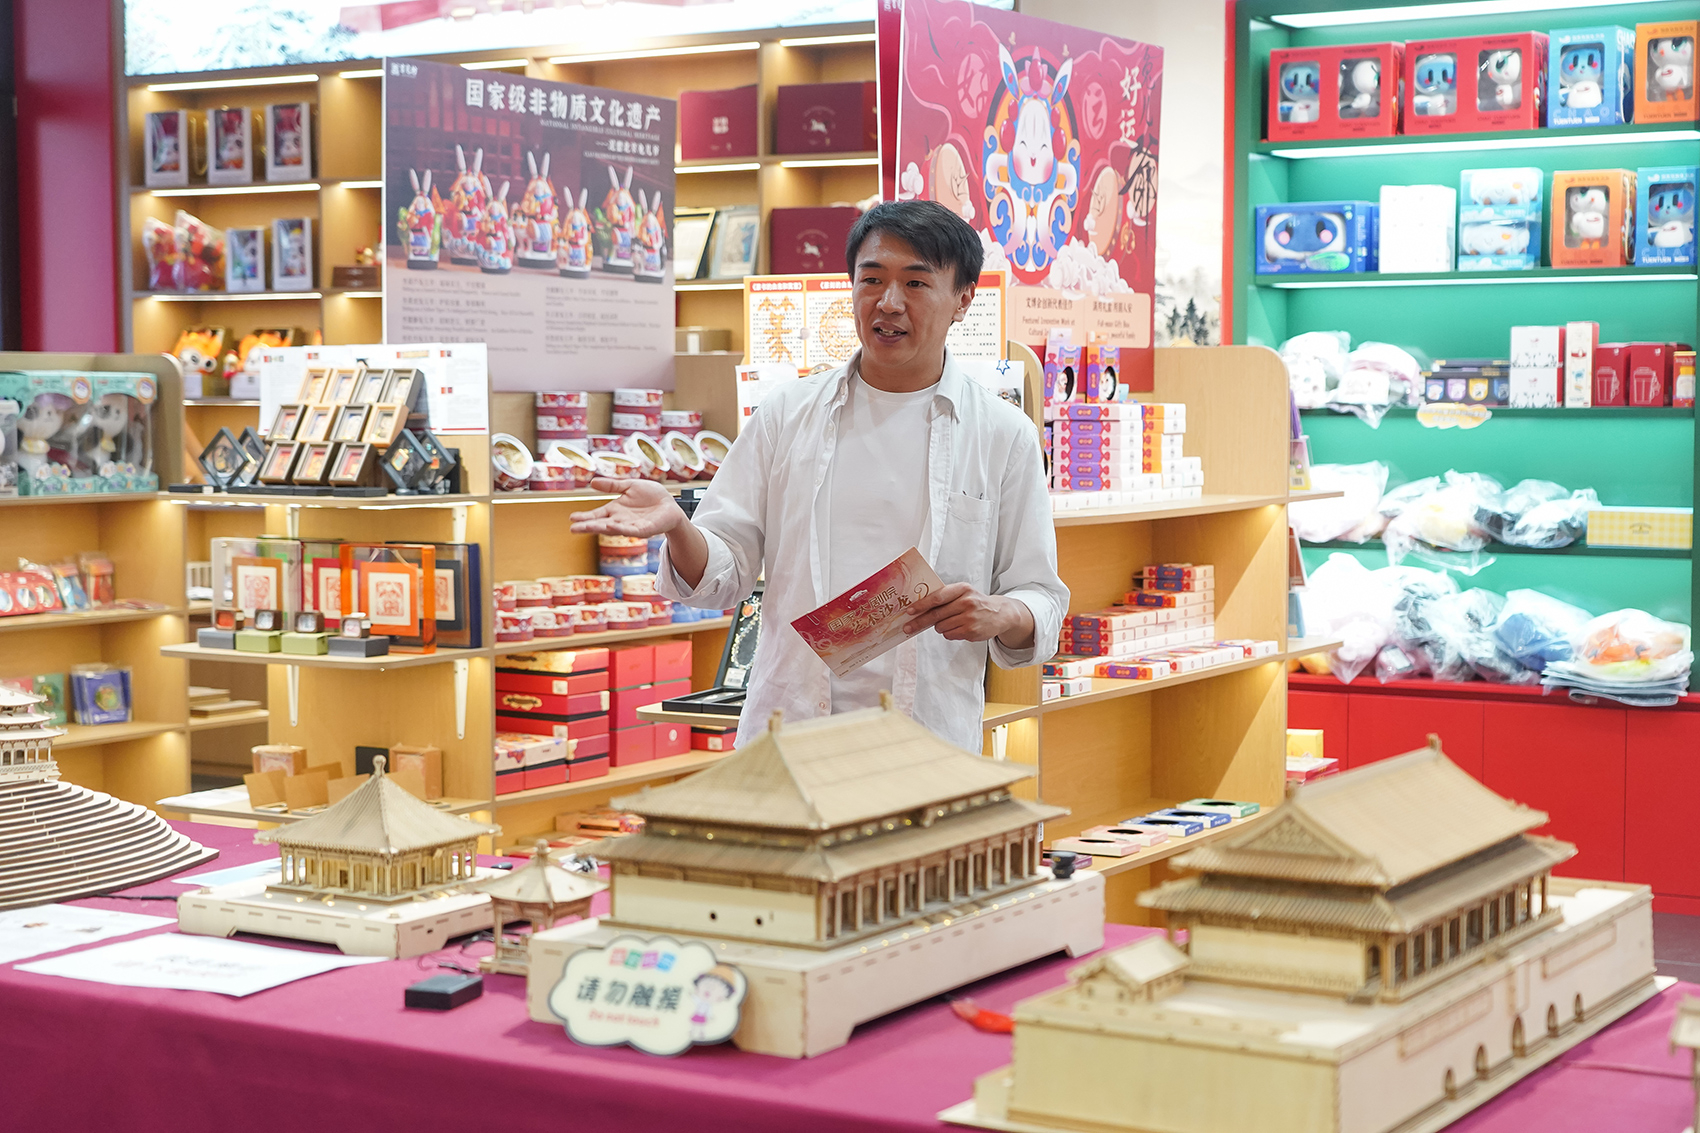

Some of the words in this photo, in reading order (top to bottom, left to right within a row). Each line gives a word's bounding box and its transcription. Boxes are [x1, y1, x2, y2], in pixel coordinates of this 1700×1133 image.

[465, 78, 661, 131] 国家级非物质文化遗产
[1119, 66, 1143, 148] 好运
[540, 119, 569, 129] NATIONAL
[571, 123, 604, 134] INTANGIBLE
[605, 128, 633, 138] CULTURAL
[633, 132, 660, 141] HERITAGE
[828, 586, 898, 633] 国家大剧院
[851, 594, 912, 635] 艺术沙龙
[576, 976, 683, 1014] 请勿触摸
[588, 1009, 604, 1021] Do
[605, 1011, 625, 1024] not
[626, 1013, 660, 1028] touch
